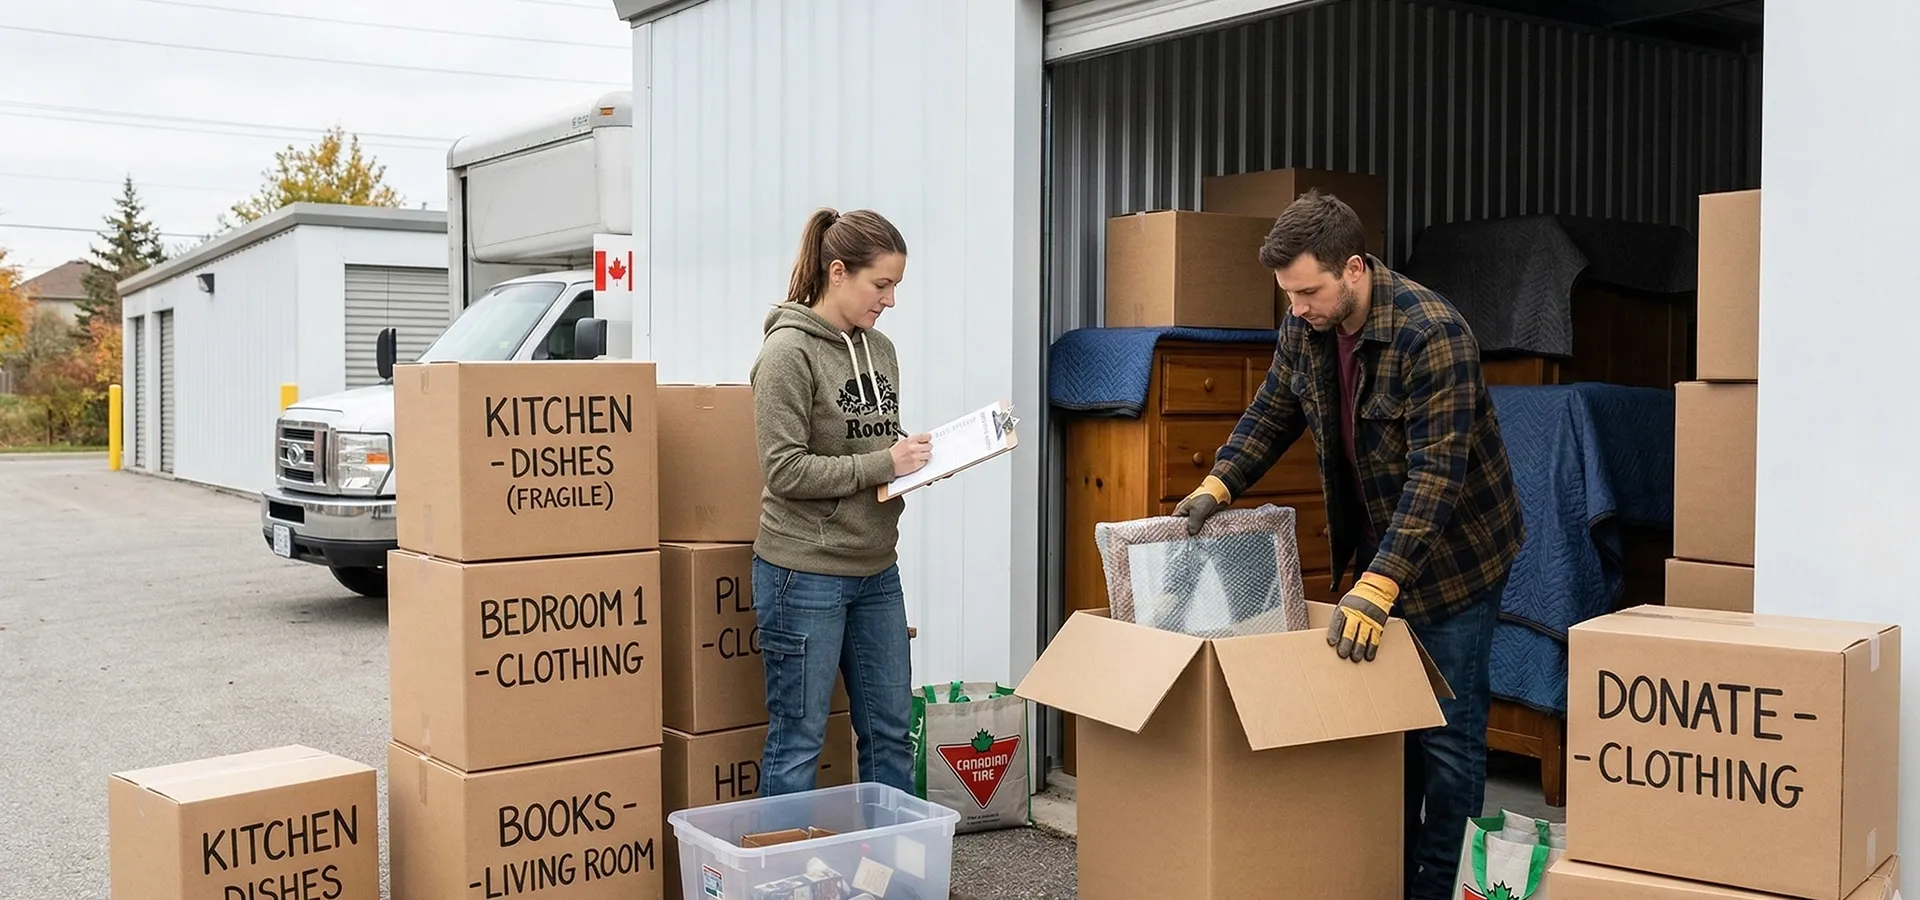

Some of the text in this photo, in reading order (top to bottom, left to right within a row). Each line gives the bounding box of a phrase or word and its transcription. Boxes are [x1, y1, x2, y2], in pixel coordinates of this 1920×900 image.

[485, 394, 632, 437] KITCHEN
[507, 480, 614, 515] (FRAGILE)
[480, 585, 648, 639] BEDROOM 1
[716, 576, 754, 614] PL
[956, 753, 1008, 771] CANADIAN
[972, 770, 995, 782] TIRE
[202, 804, 358, 875] KITCHEN
[584, 837, 655, 881] ROOM
